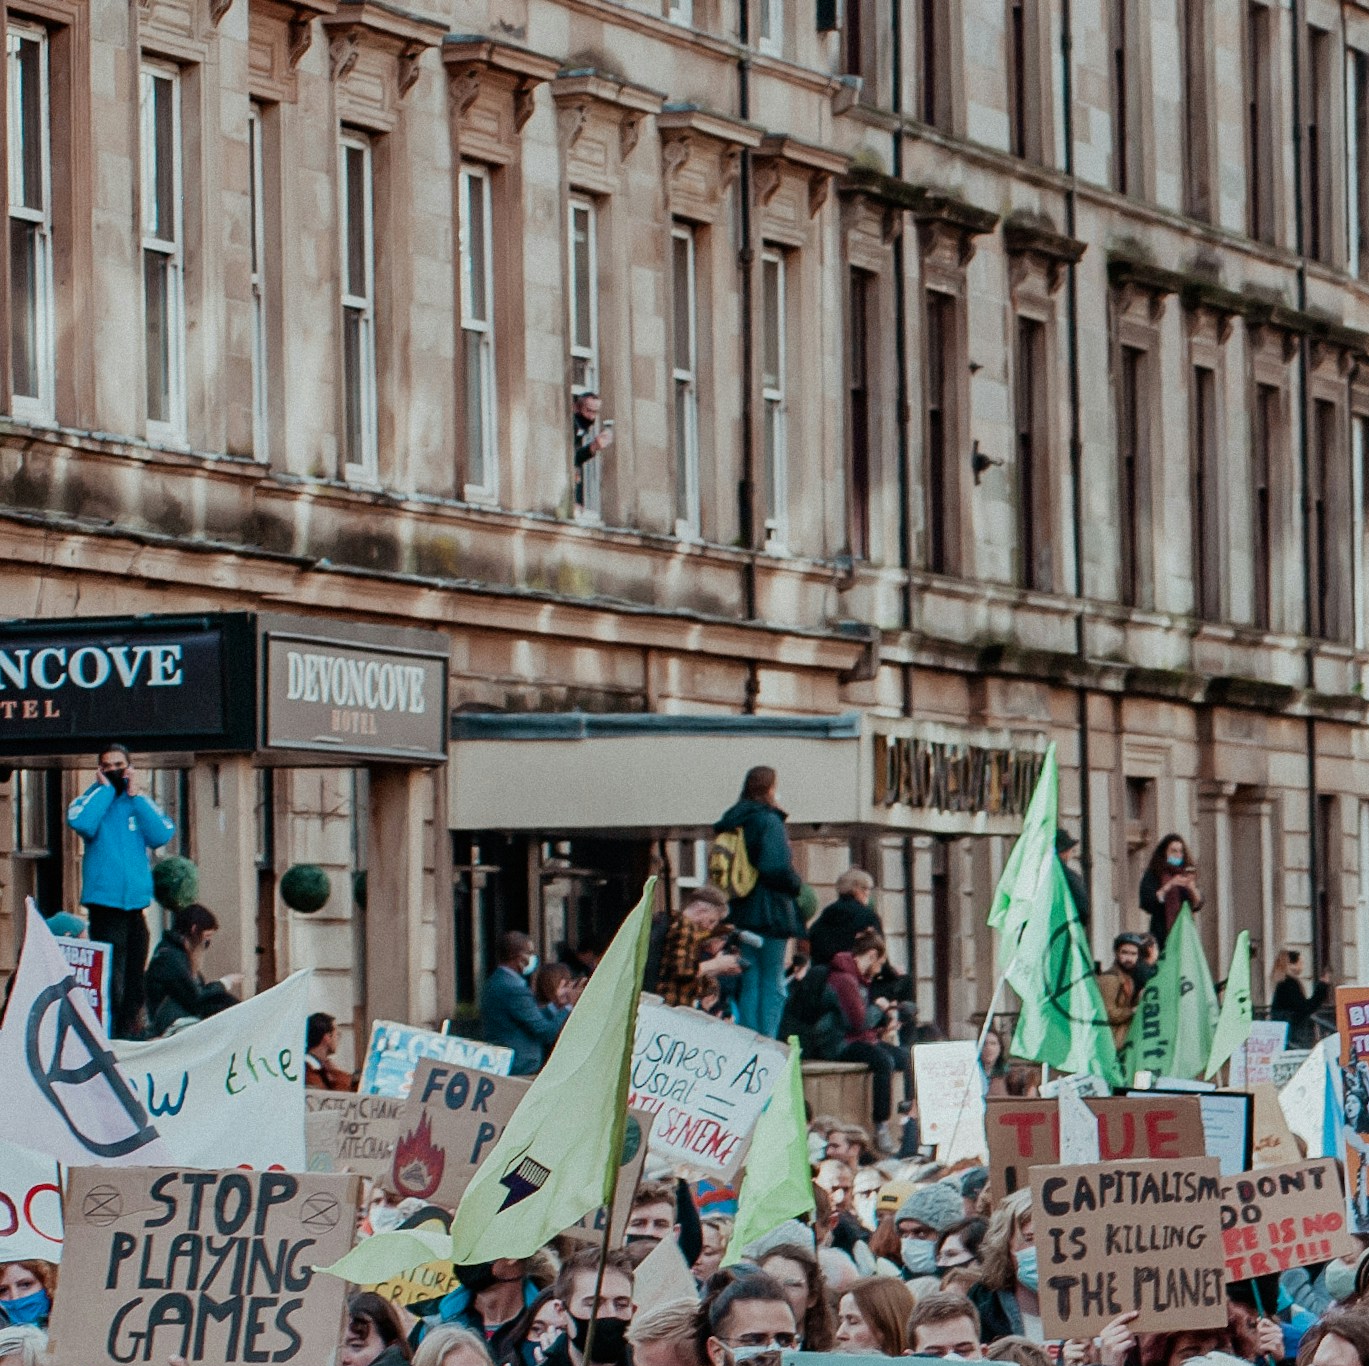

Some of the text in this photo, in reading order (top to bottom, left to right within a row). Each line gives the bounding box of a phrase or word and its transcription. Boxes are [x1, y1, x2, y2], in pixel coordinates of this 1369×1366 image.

[286, 651, 426, 714] DEVONCOVE
[331, 709, 378, 735] HOTEL
[226, 1045, 298, 1095] the
[420, 1067, 496, 1113] FOR
[999, 1110, 1182, 1159] TUE
[144, 1172, 299, 1236] STOP
[1041, 1169, 1221, 1216] CAPITALISM
[1049, 1223, 1206, 1264] IS KILLING
[1268, 1217, 1295, 1244] IS
[1302, 1210, 1344, 1238] NO
[105, 1231, 316, 1296] PLAYING
[1047, 1265, 1225, 1322] THE PLANET
[107, 1293, 303, 1363] GAMES
